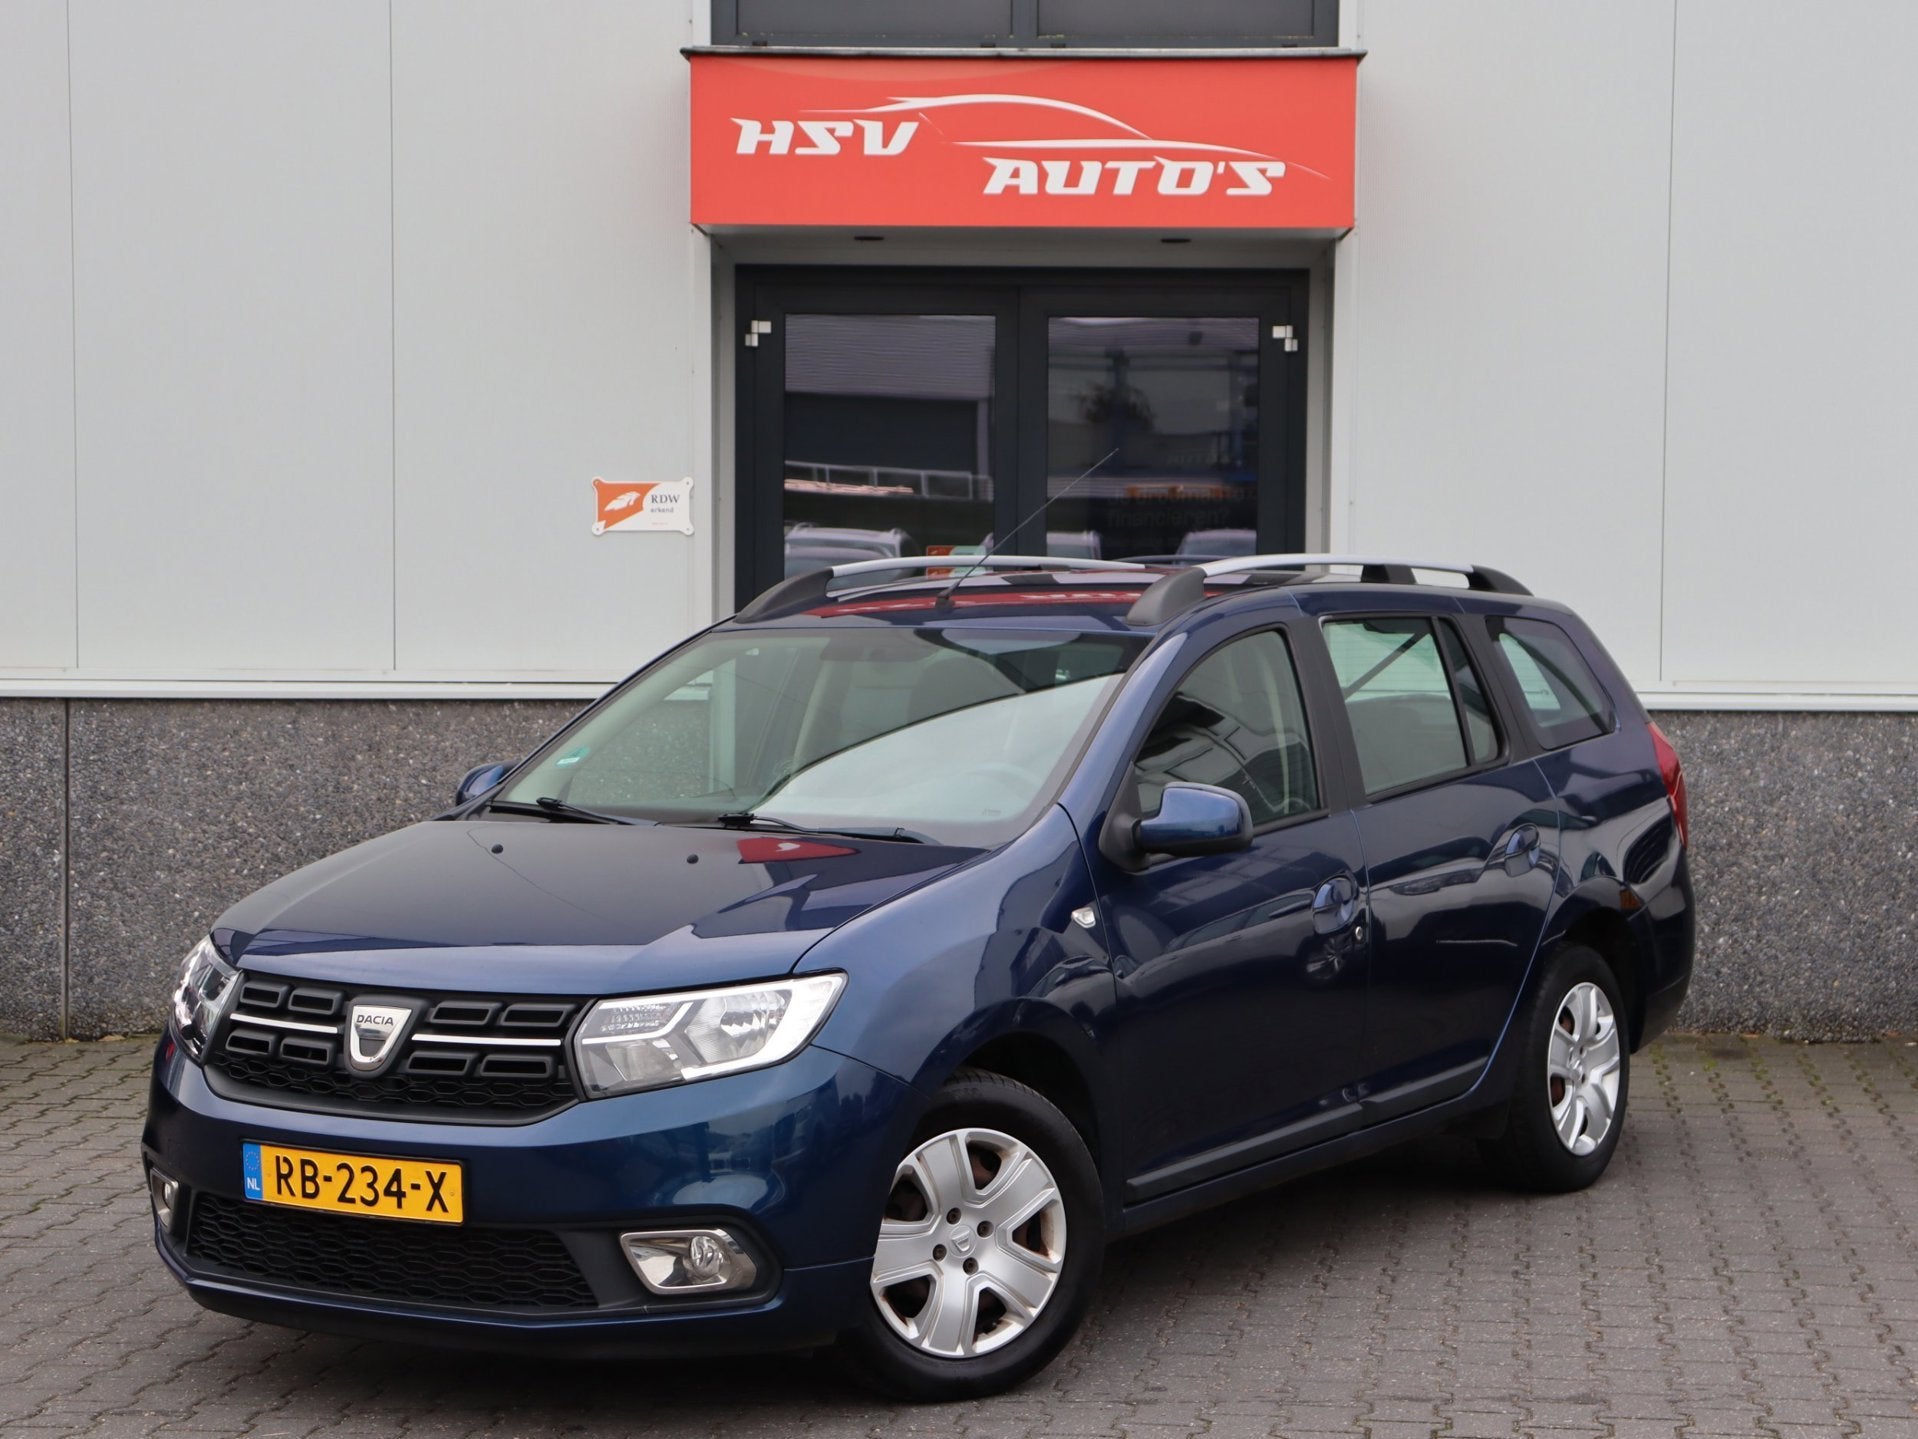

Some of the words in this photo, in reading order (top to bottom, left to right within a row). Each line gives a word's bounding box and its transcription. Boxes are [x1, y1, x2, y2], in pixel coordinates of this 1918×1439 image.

[730, 117, 918, 155] HSV
[982, 156, 1286, 195] AUTO'S
[650, 494, 680, 504] RDW
[356, 1014, 394, 1026] DACIA
[246, 1177, 261, 1191] NL
[275, 1155, 449, 1213] RB-234-X
